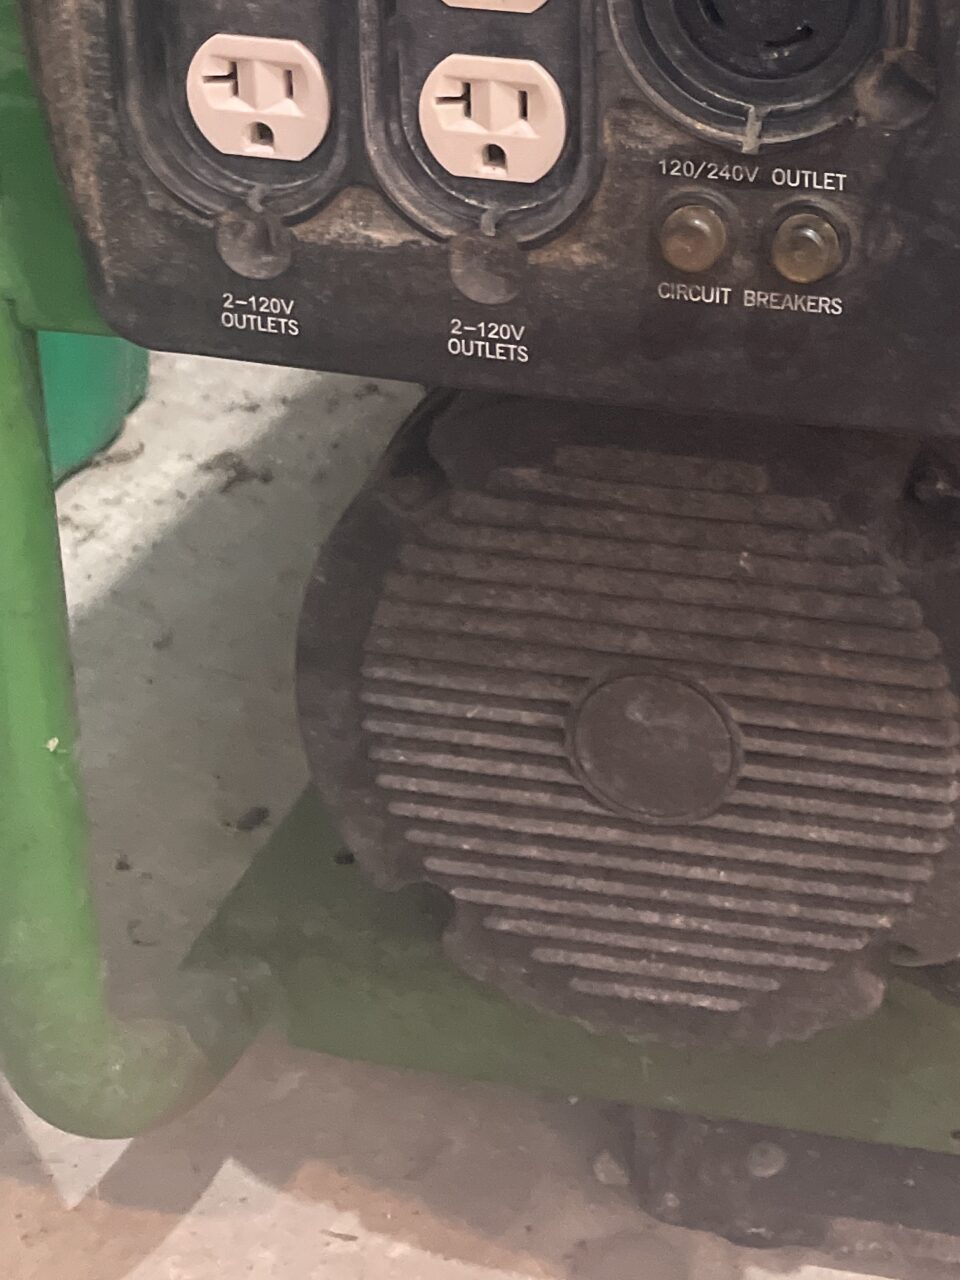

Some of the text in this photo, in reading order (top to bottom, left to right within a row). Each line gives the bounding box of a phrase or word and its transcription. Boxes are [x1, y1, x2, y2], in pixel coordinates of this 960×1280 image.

[658, 159, 848, 192] 120/240V OUTLET
[222, 292, 295, 316] 2-120V
[656, 281, 844, 316] CIRCUIT BREAKERS
[220, 311, 300, 336] OUTLETS
[449, 318, 526, 342] 2-120V
[447, 337, 530, 363] OUTLETS
